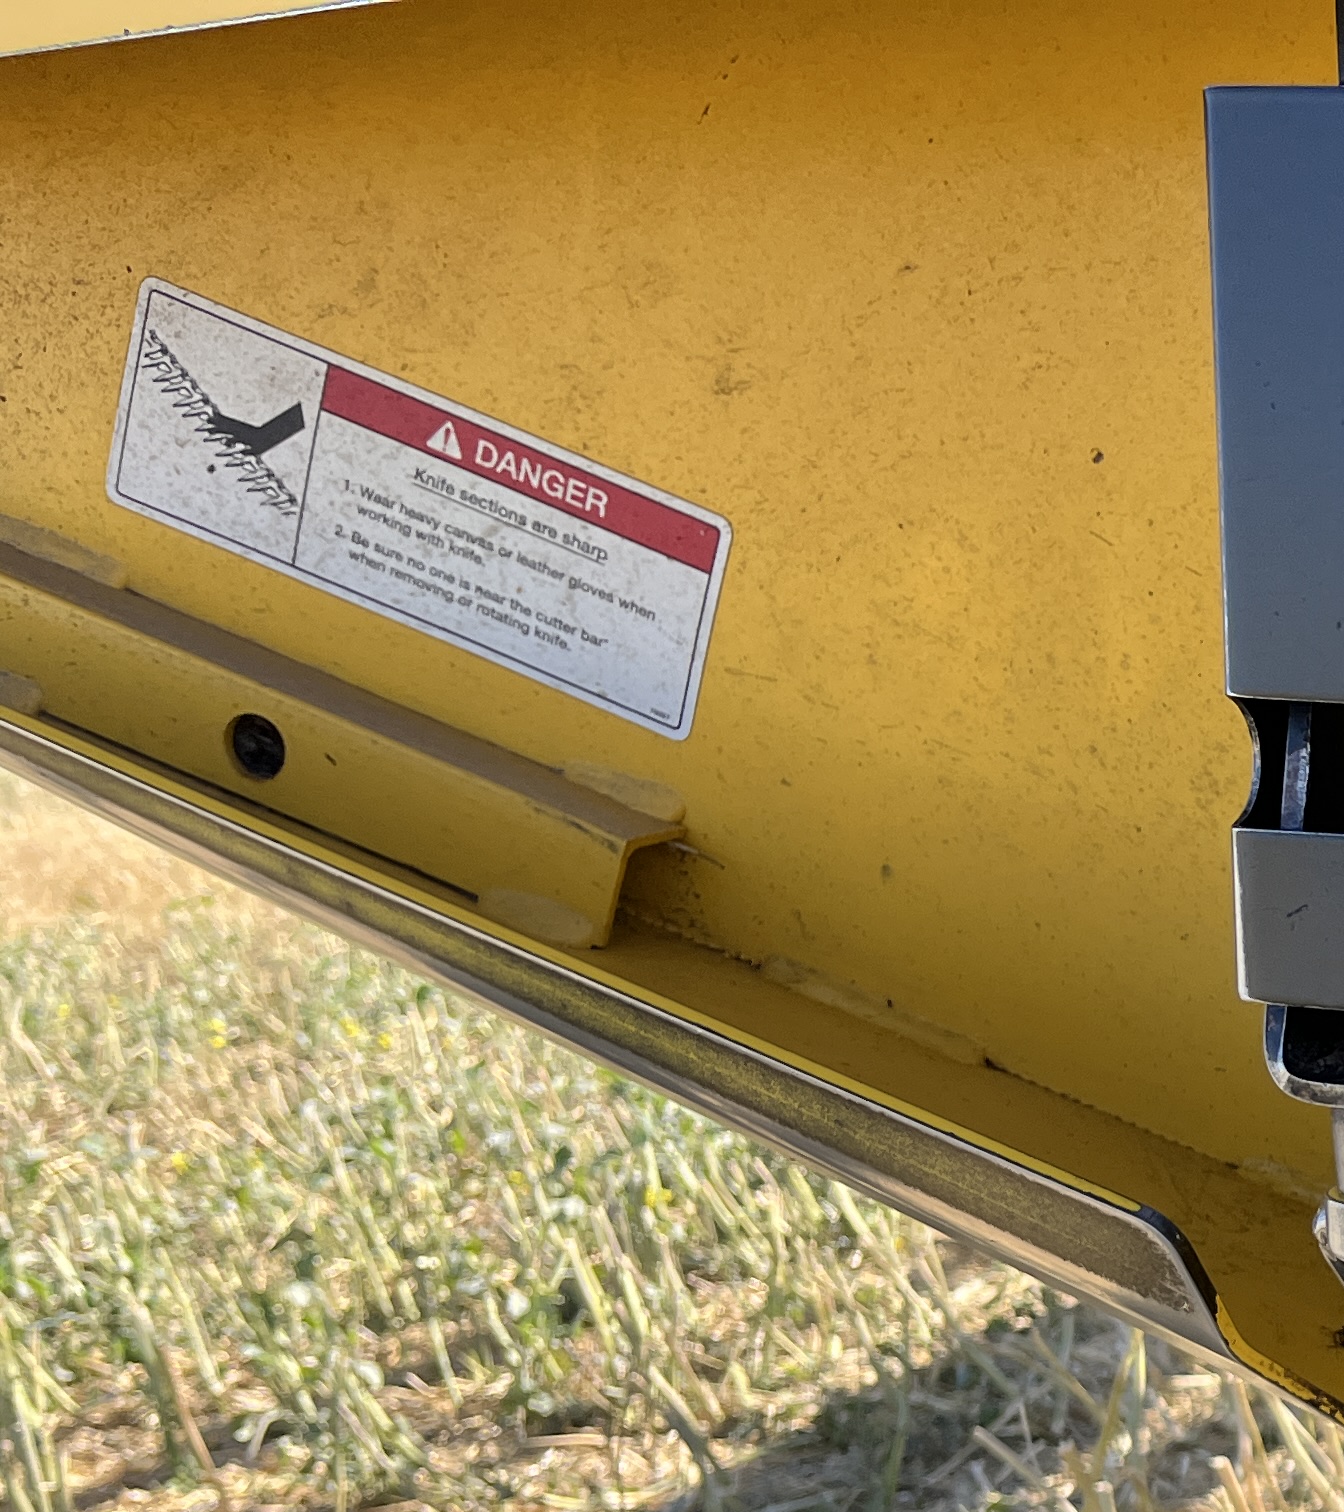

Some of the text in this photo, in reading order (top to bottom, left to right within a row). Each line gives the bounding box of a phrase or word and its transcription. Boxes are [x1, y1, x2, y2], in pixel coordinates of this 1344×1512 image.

[413, 467, 608, 562] Knife sections are sharp
[474, 439, 609, 518] DANGER
[334, 523, 347, 539] 2.
[351, 530, 370, 549] Be
[374, 541, 403, 562] sure
[406, 556, 426, 571] no
[428, 565, 456, 584] one
[458, 576, 470, 590] is
[474, 584, 506, 606] near
[509, 598, 532, 616] the
[535, 610, 578, 635] cutter
[343, 479, 656, 621] 1. Wear heavy canvas or leather gloves when
[356, 504, 486, 567] working with knife.
[348, 550, 571, 651] when removing or rotating knife.
